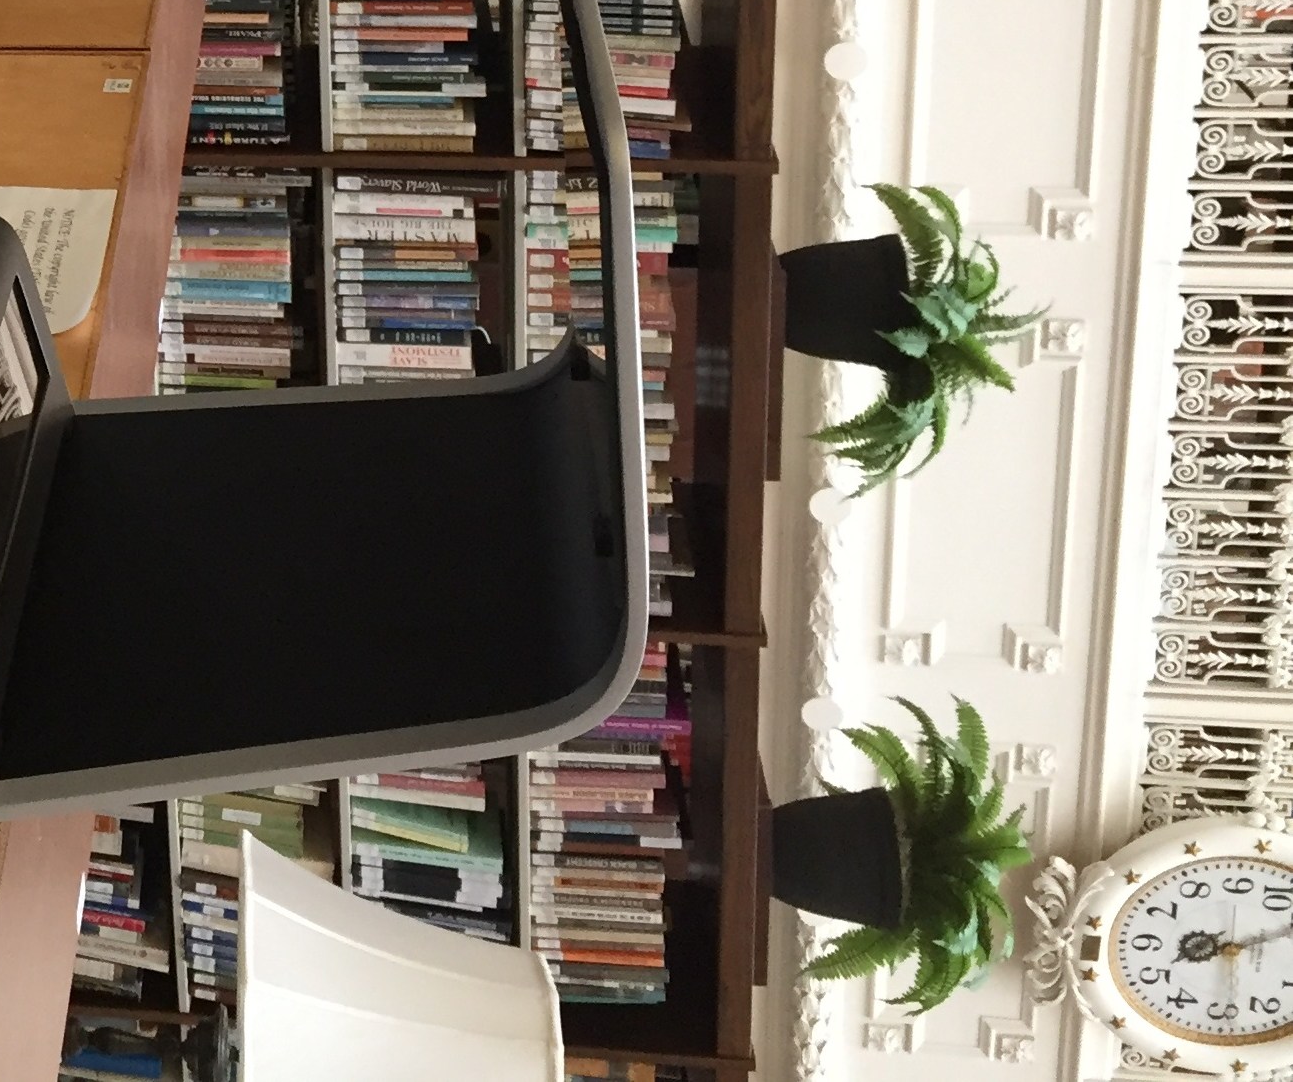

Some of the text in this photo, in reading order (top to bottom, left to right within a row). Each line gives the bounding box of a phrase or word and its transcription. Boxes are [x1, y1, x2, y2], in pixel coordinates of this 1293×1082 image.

[190, 133, 266, 145] TURBULENT
[405, 180, 441, 193] World
[390, 347, 461, 357] TESTIMONY
[390, 357, 428, 366] SLAVE
[1180, 881, 1211, 899] 8
[1222, 877, 1254, 894] 9
[1262, 885, 1293, 912] 10
[1146, 902, 1177, 920] 7
[1131, 934, 1162, 952] 6
[1140, 967, 1170, 985] 5
[1167, 989, 1198, 1009] 4
[1250, 997, 1281, 1014] 2
[1207, 1003, 1238, 1020] 3
